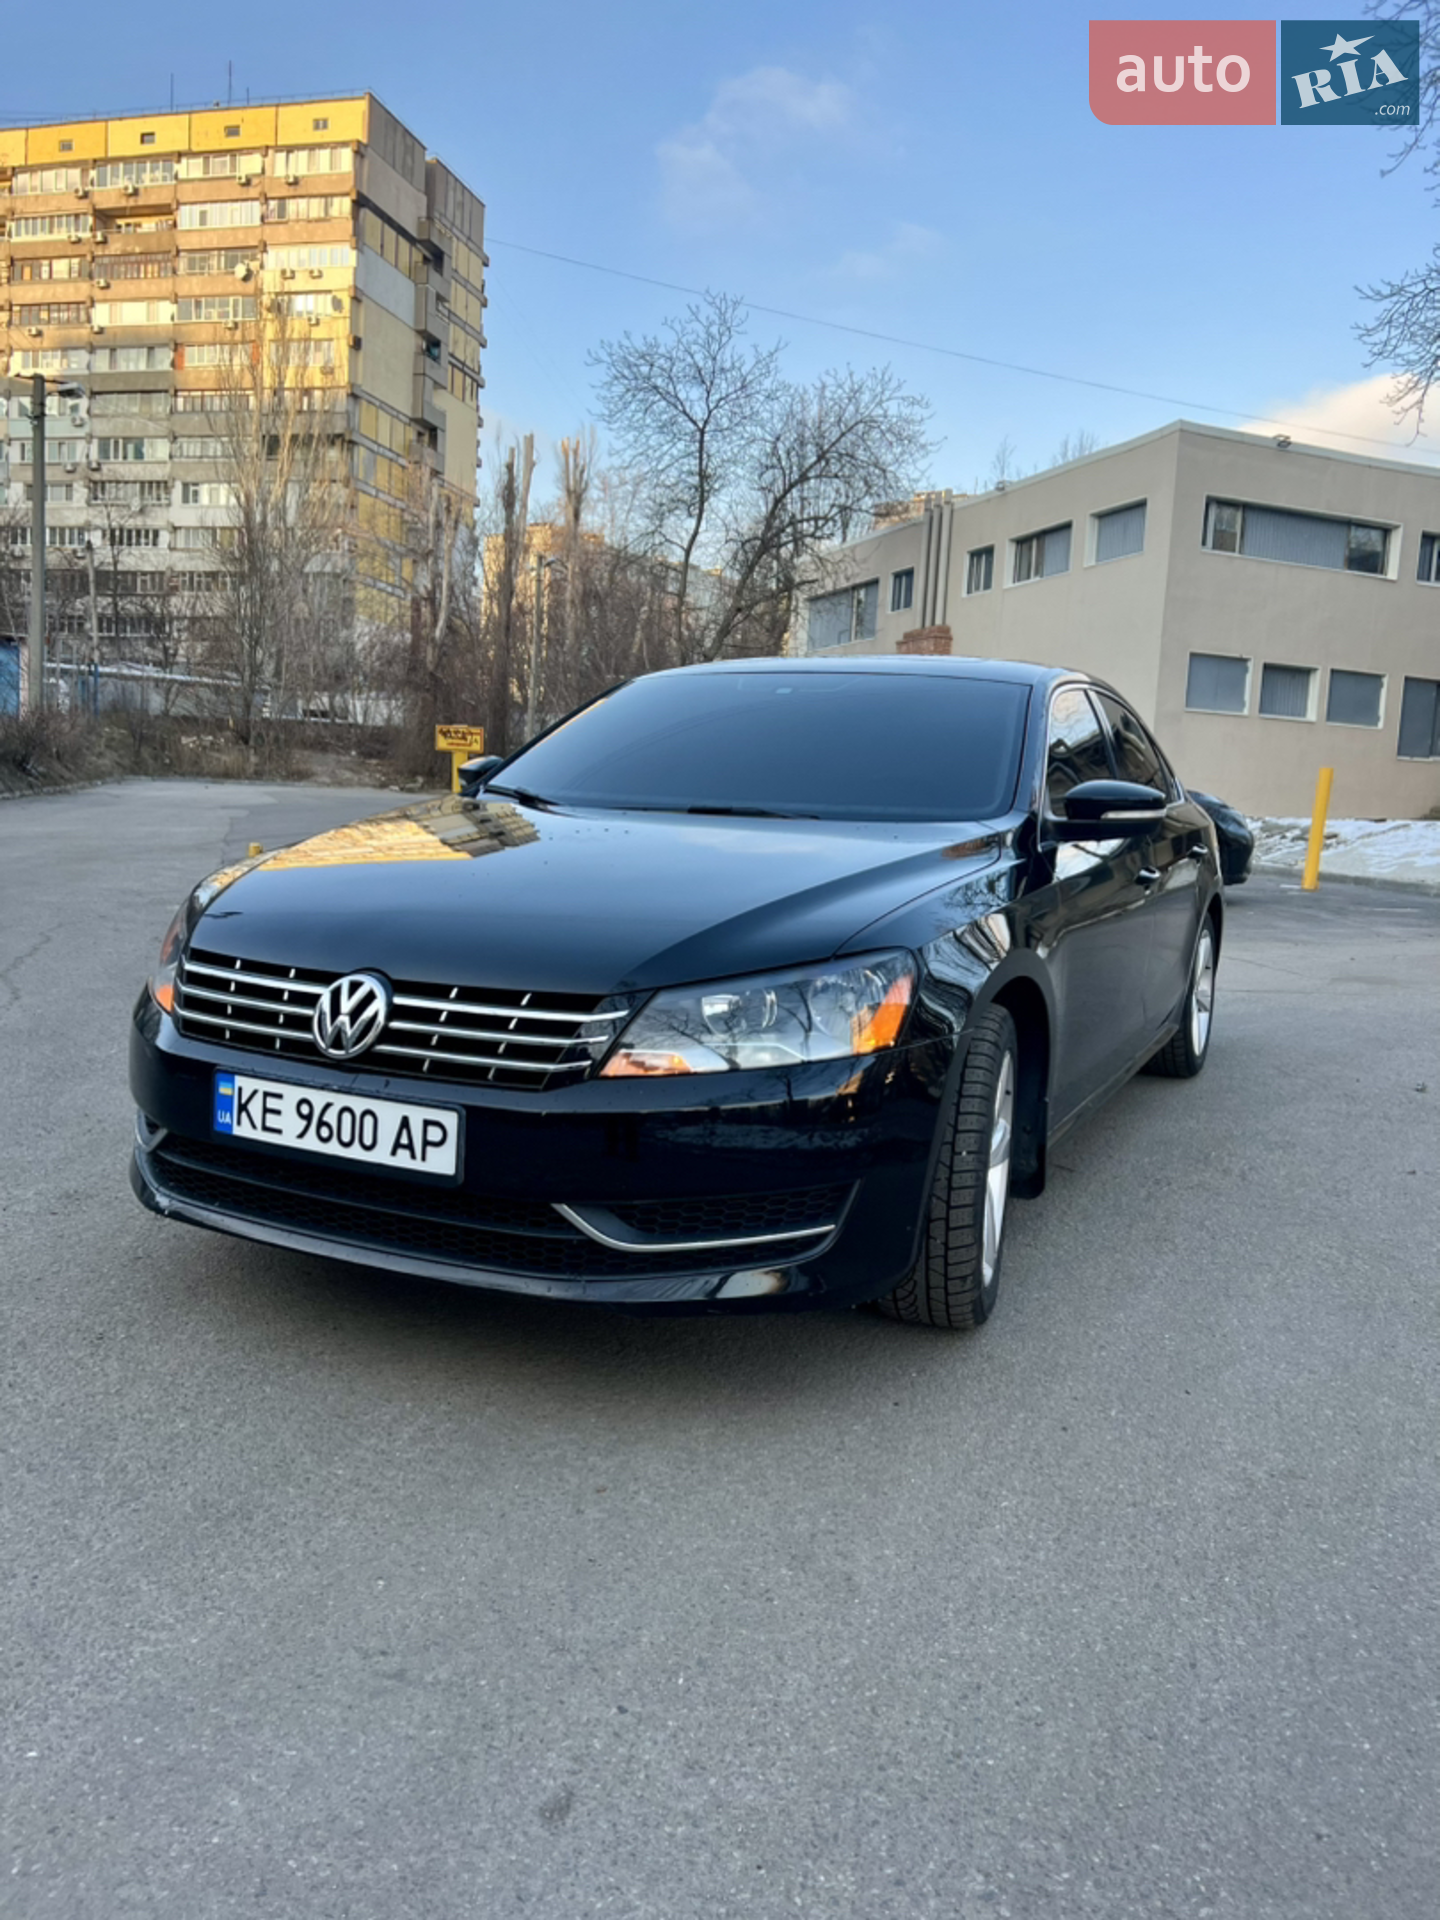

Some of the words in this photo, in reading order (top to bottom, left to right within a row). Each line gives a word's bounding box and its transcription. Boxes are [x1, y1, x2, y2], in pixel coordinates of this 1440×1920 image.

[217, 1110, 232, 1124] UA
[236, 1086, 284, 1135] KE
[295, 1097, 378, 1152] 9600
[390, 1115, 448, 1162] AP
